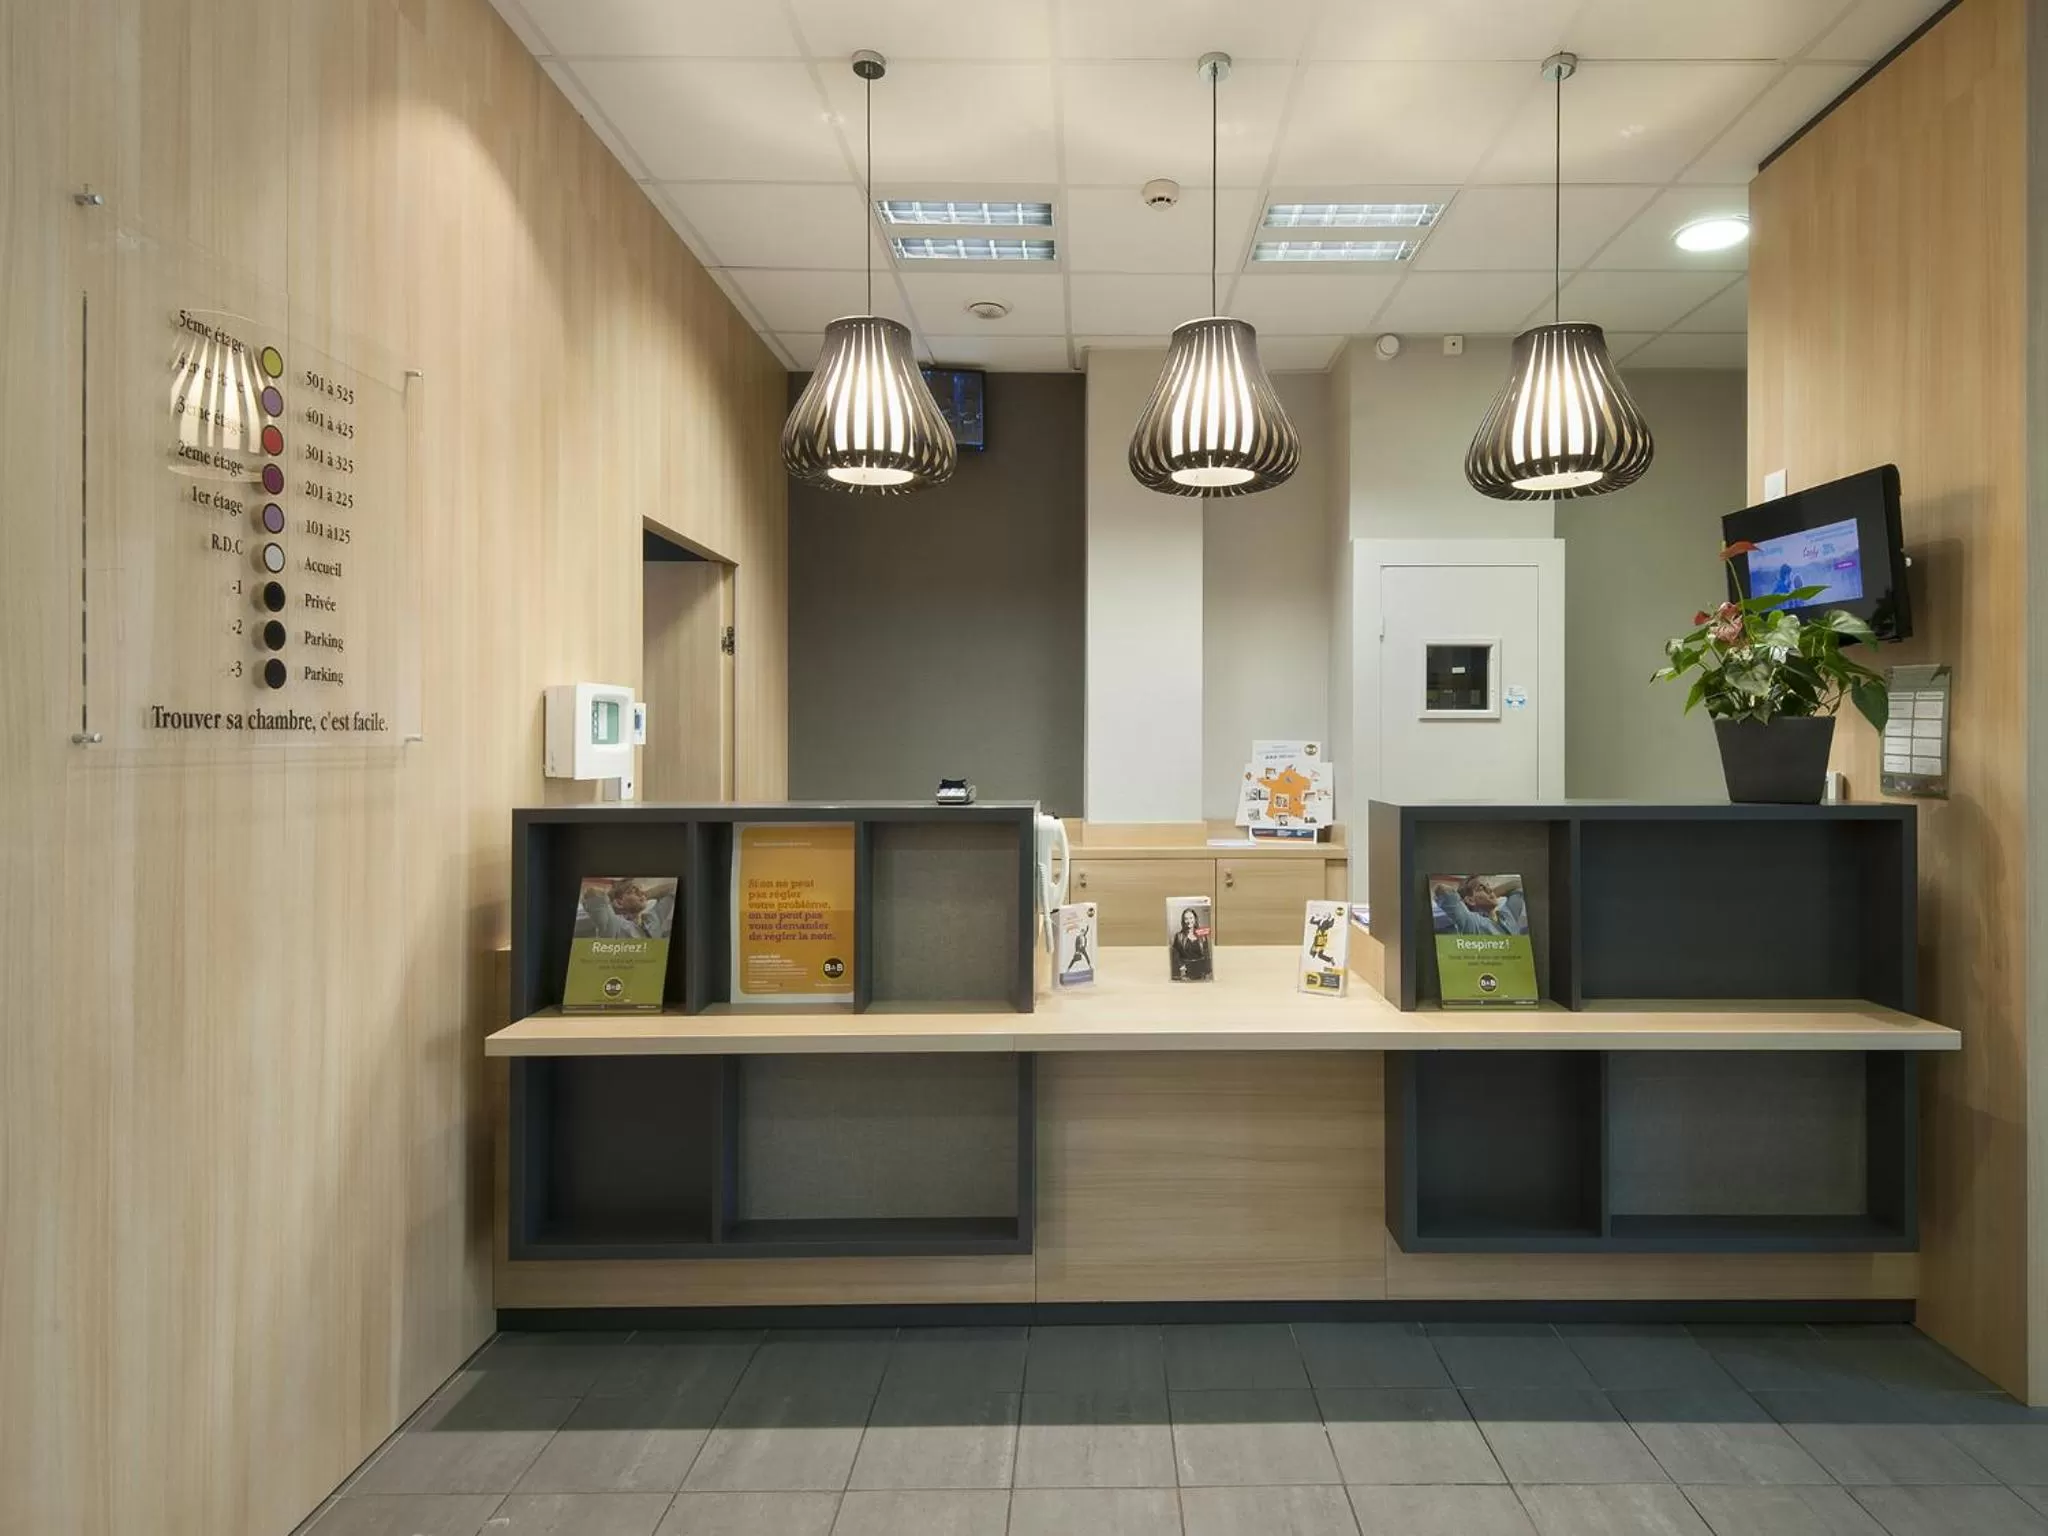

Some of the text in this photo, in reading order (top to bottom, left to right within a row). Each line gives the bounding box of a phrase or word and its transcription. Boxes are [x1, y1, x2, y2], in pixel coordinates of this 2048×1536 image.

[178, 309, 245, 353] 5ème étage
[305, 370, 355, 405] 501 à 525
[305, 407, 354, 440] 401 à 425
[177, 439, 244, 476] 2ème étage
[305, 444, 354, 474] 301 à 325
[191, 485, 244, 515] 1er étage
[305, 480, 354, 509] 201 à 225
[305, 519, 325, 537] 101
[211, 533, 244, 555] R.D.C
[304, 556, 342, 578] Accueil
[232, 579, 242, 595] -1
[304, 593, 337, 612] Privée
[232, 619, 243, 635] -2
[304, 630, 344, 653] Parking
[231, 660, 243, 678] -3
[304, 665, 344, 687] Parking
[151, 705, 389, 734] Trouver sa chambre, c'est facile.
[748, 889, 801, 900] pas régler
[791, 879, 815, 890] peut
[775, 920, 829, 930] demander
[779, 911, 803, 920] peut
[804, 912, 823, 921] pas
[748, 931, 761, 940] de
[764, 931, 796, 943] régler
[799, 931, 809, 940] la
